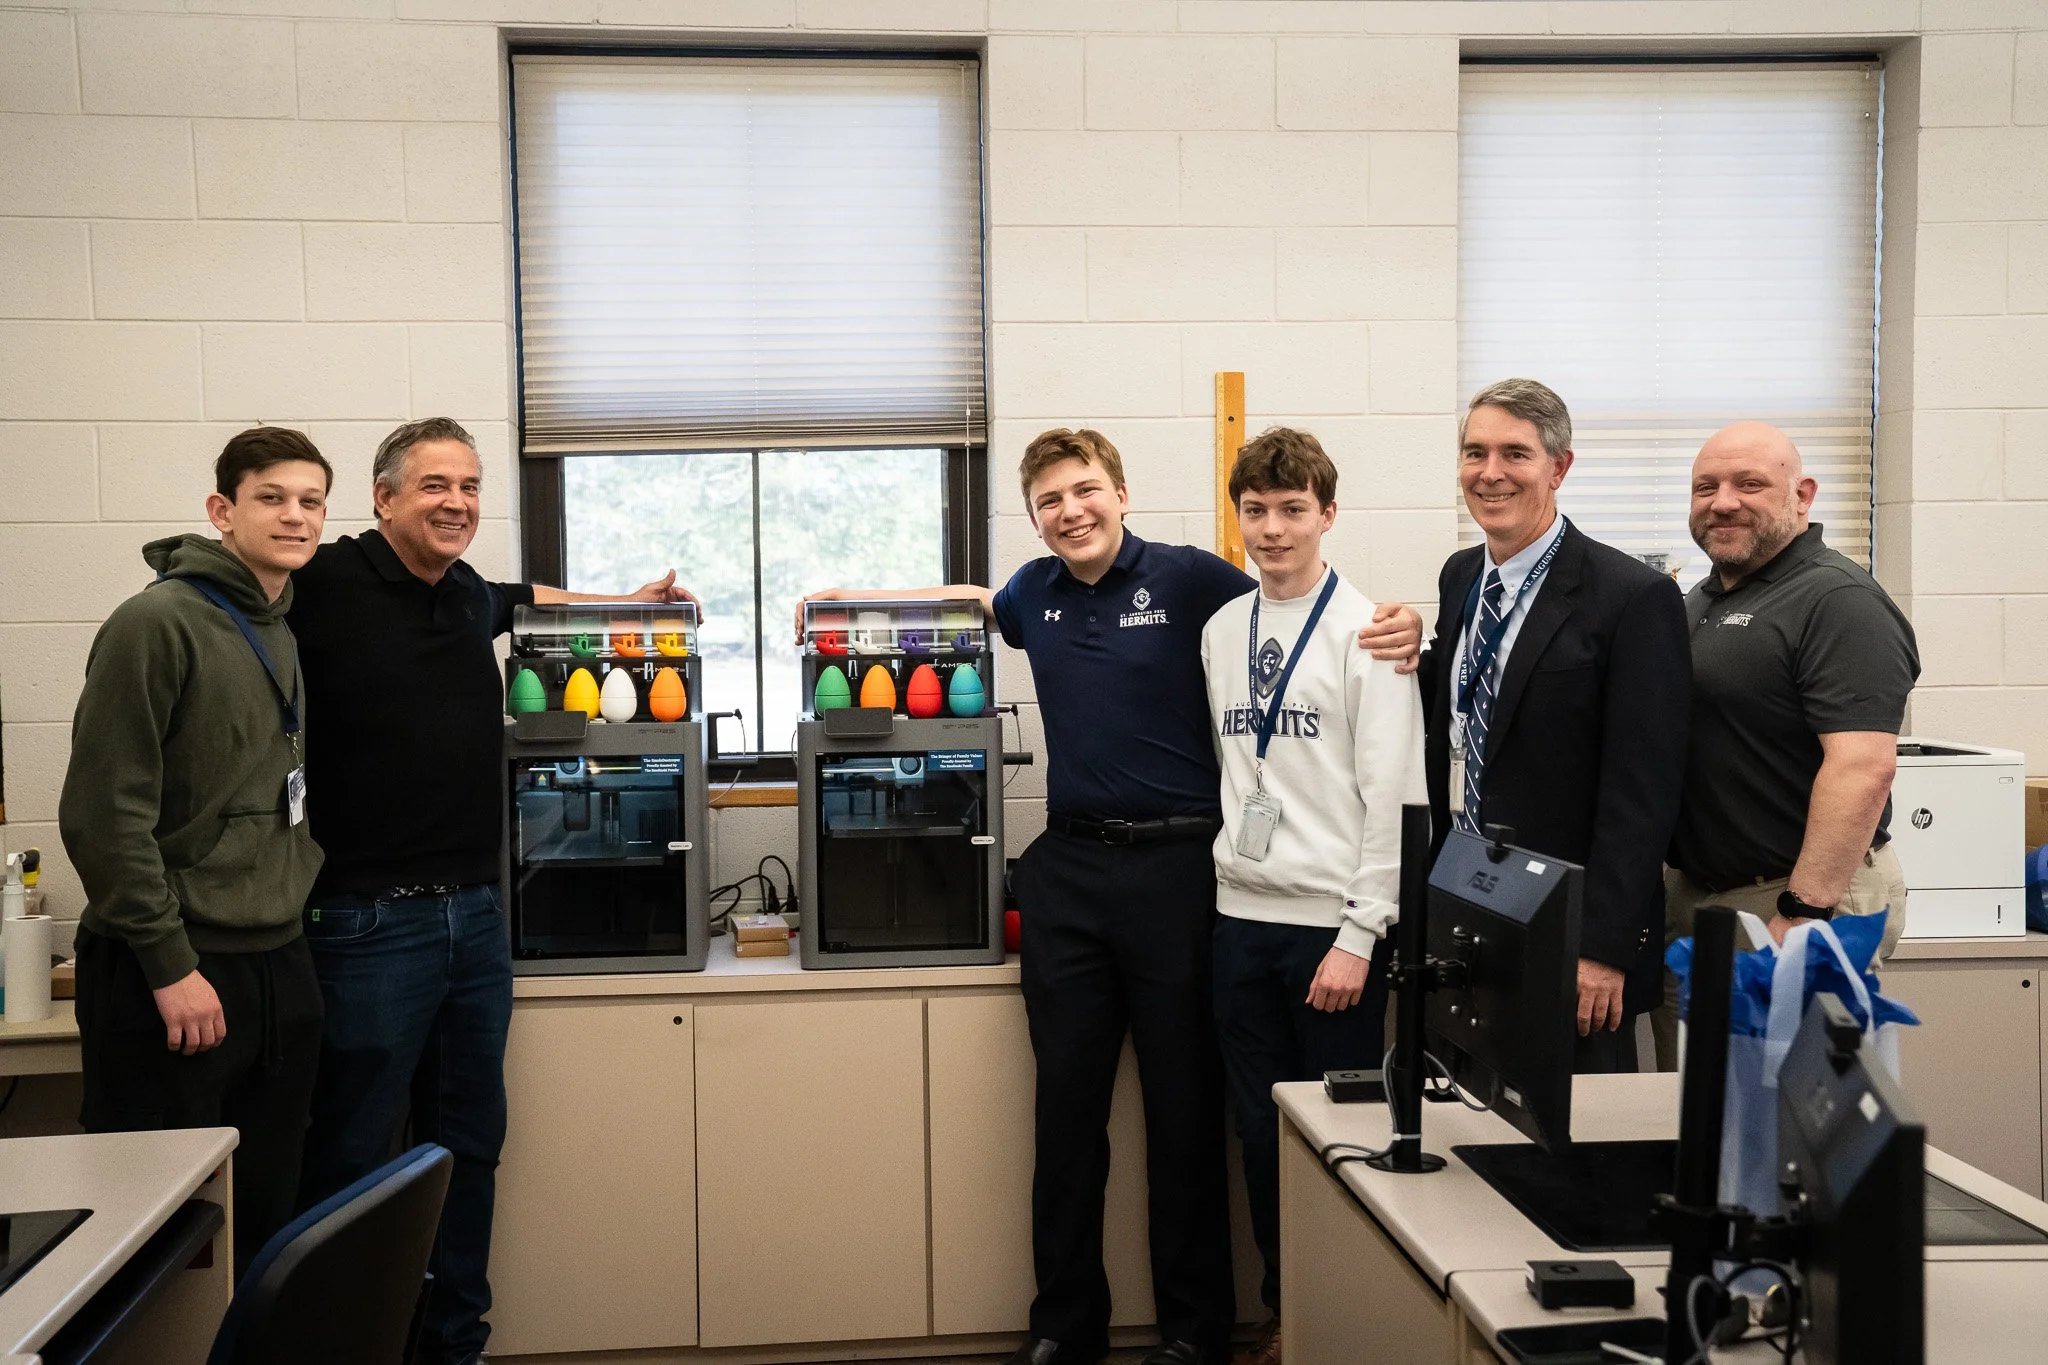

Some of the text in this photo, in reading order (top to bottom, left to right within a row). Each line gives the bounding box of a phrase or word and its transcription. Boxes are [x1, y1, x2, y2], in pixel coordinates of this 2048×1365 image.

[1522, 580, 1533, 591] ST.
[1531, 538, 1562, 581] AUGUSTINE
[1120, 614, 1166, 627] HERMITS
[1460, 663, 1468, 686] PREP
[1292, 702, 1319, 712] PREP
[1914, 808, 1931, 829] hp
[1467, 870, 1500, 894] ASUS
